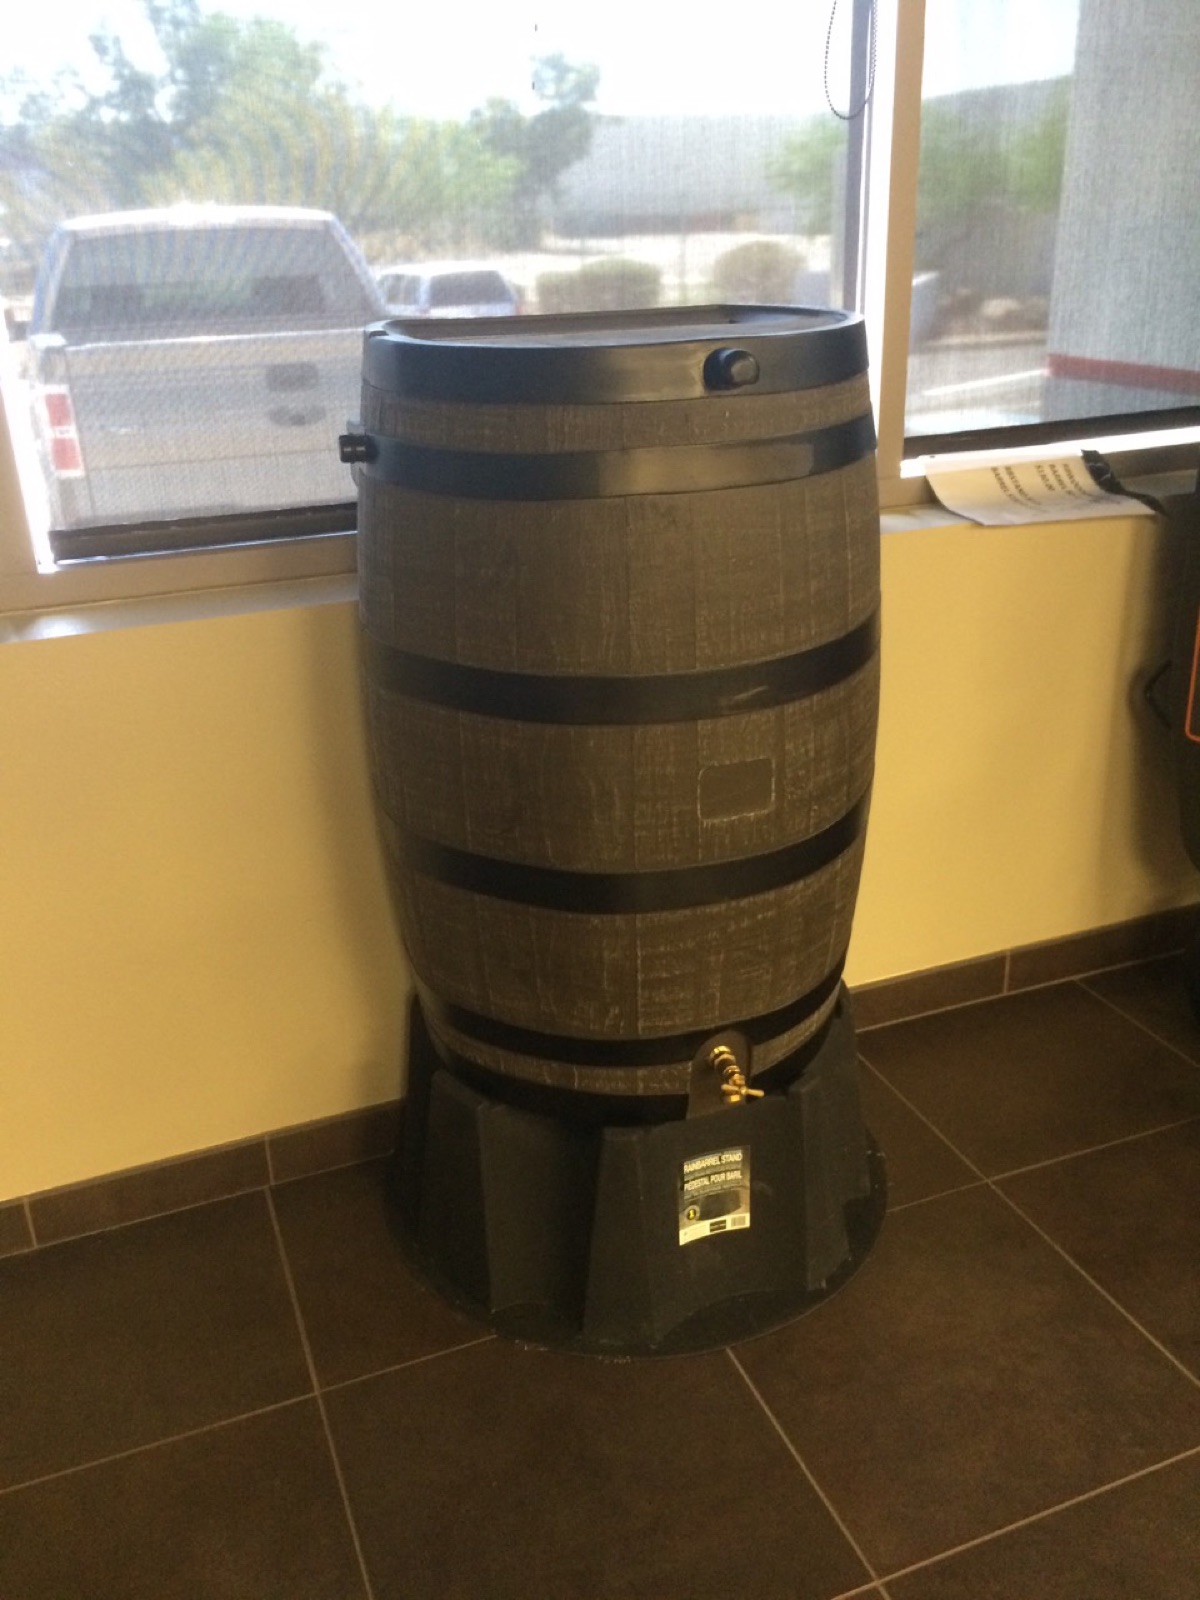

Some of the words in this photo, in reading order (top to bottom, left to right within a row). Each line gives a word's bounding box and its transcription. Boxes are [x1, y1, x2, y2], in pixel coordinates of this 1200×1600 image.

[721, 1154, 742, 1163] STAND
[710, 1173, 726, 1183] POUR
[726, 1170, 742, 1181] BARIL
